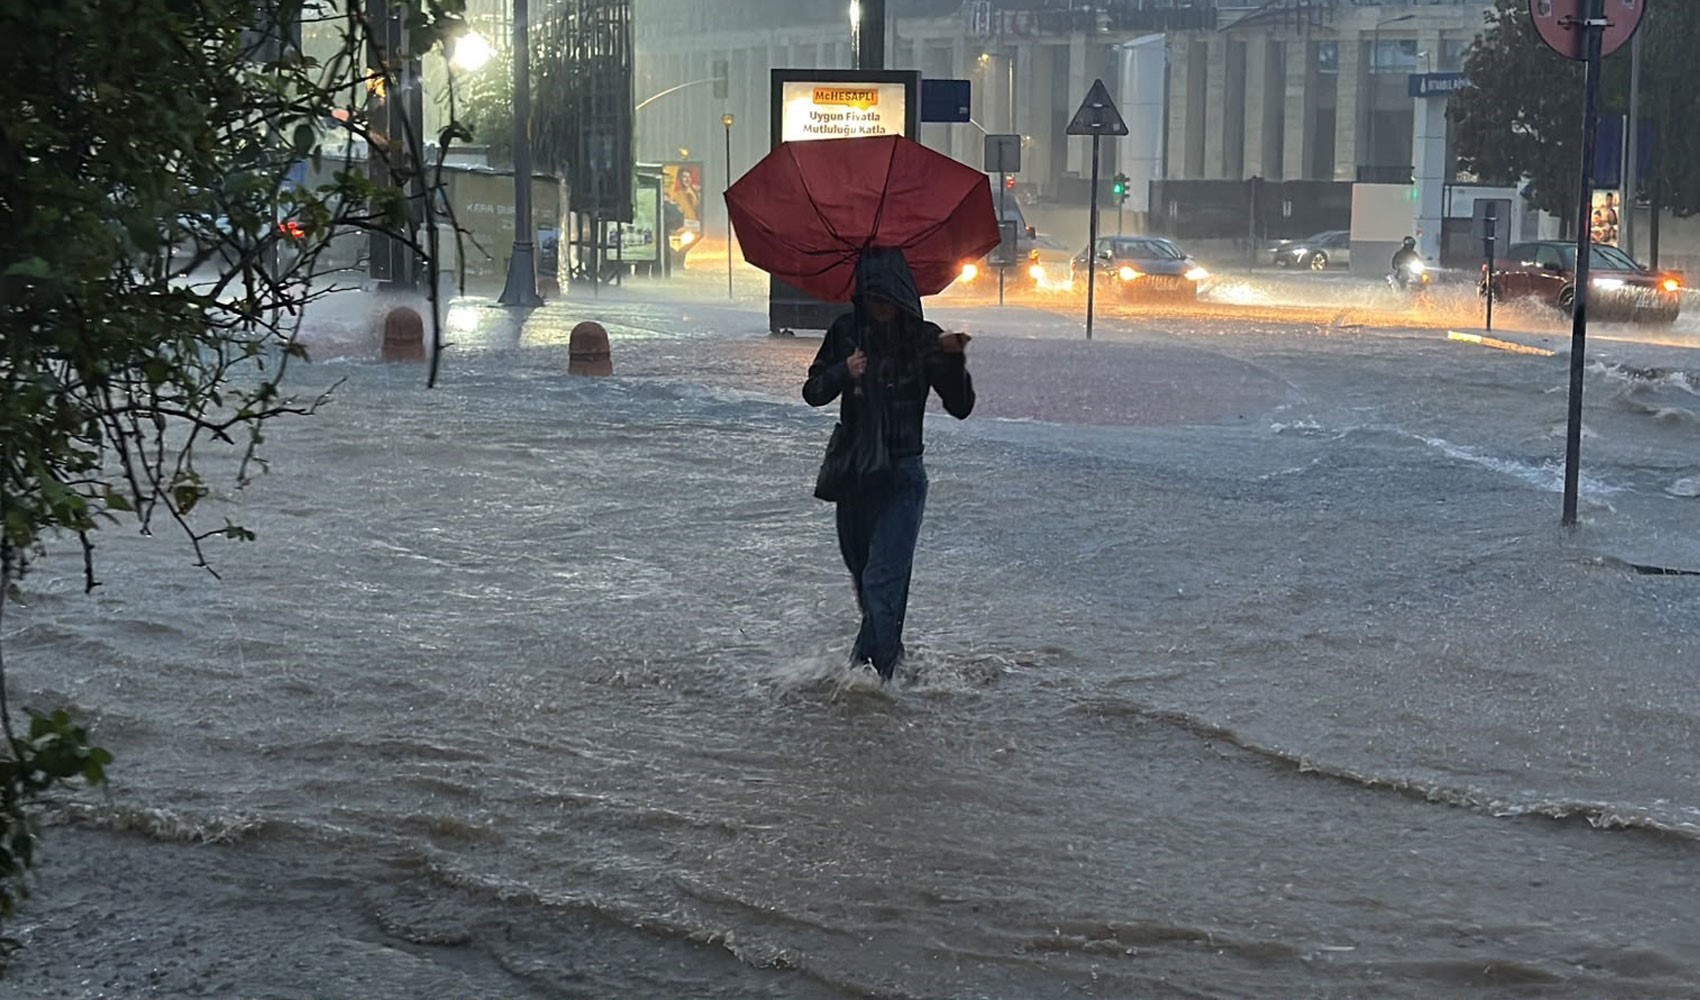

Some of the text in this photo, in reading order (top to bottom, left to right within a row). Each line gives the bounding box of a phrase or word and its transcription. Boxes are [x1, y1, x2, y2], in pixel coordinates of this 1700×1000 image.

[815, 90, 875, 101] McHESAPLI
[810, 111, 880, 122] Uygun Fiyatla
[803, 124, 886, 136] Mutluluğu Katla
